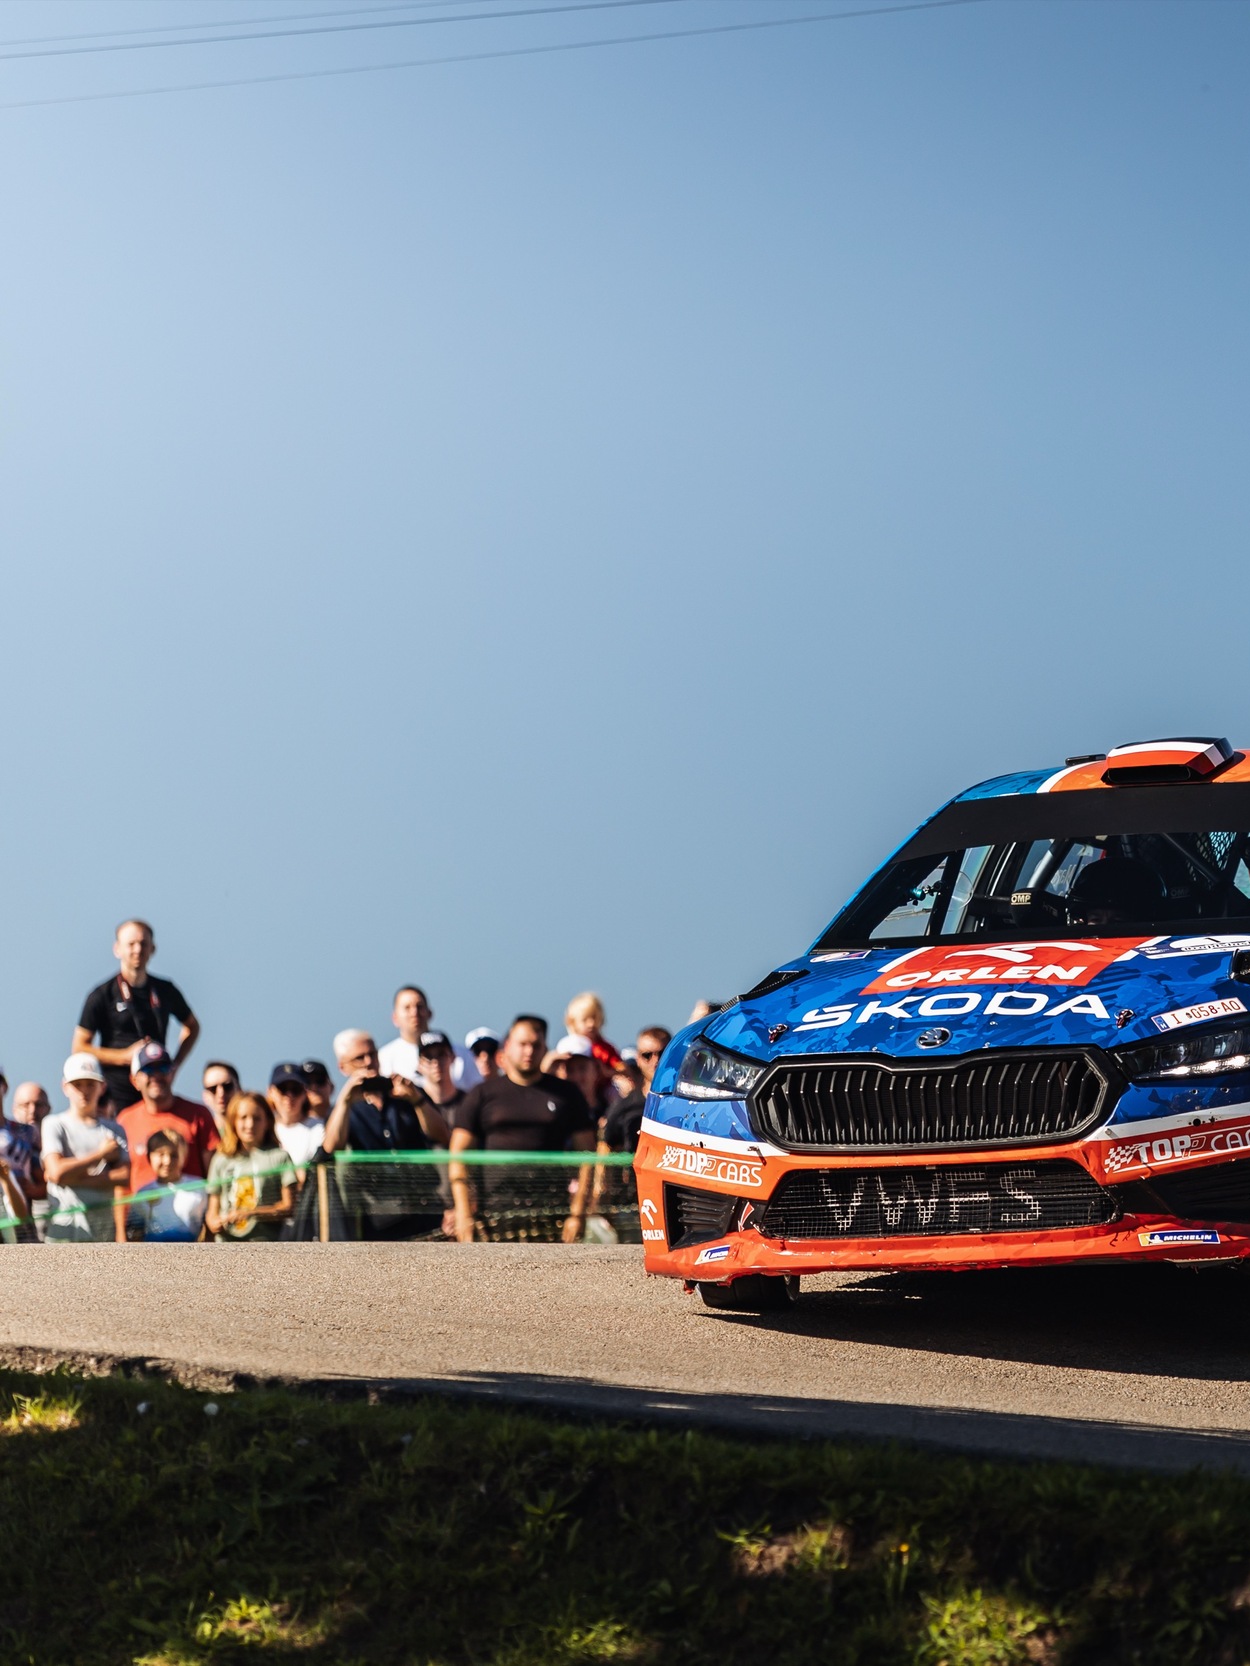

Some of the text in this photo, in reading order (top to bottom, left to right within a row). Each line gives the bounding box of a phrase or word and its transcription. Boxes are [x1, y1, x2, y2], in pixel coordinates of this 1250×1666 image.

[1010, 894, 1031, 904] OMP
[885, 964, 1089, 987] ORLEN
[717, 1162, 763, 1187] CARS
[818, 1169, 1042, 1231] VWFS
[642, 1229, 665, 1240] ORLEN
[1163, 1234, 1212, 1242] MICHELIN
